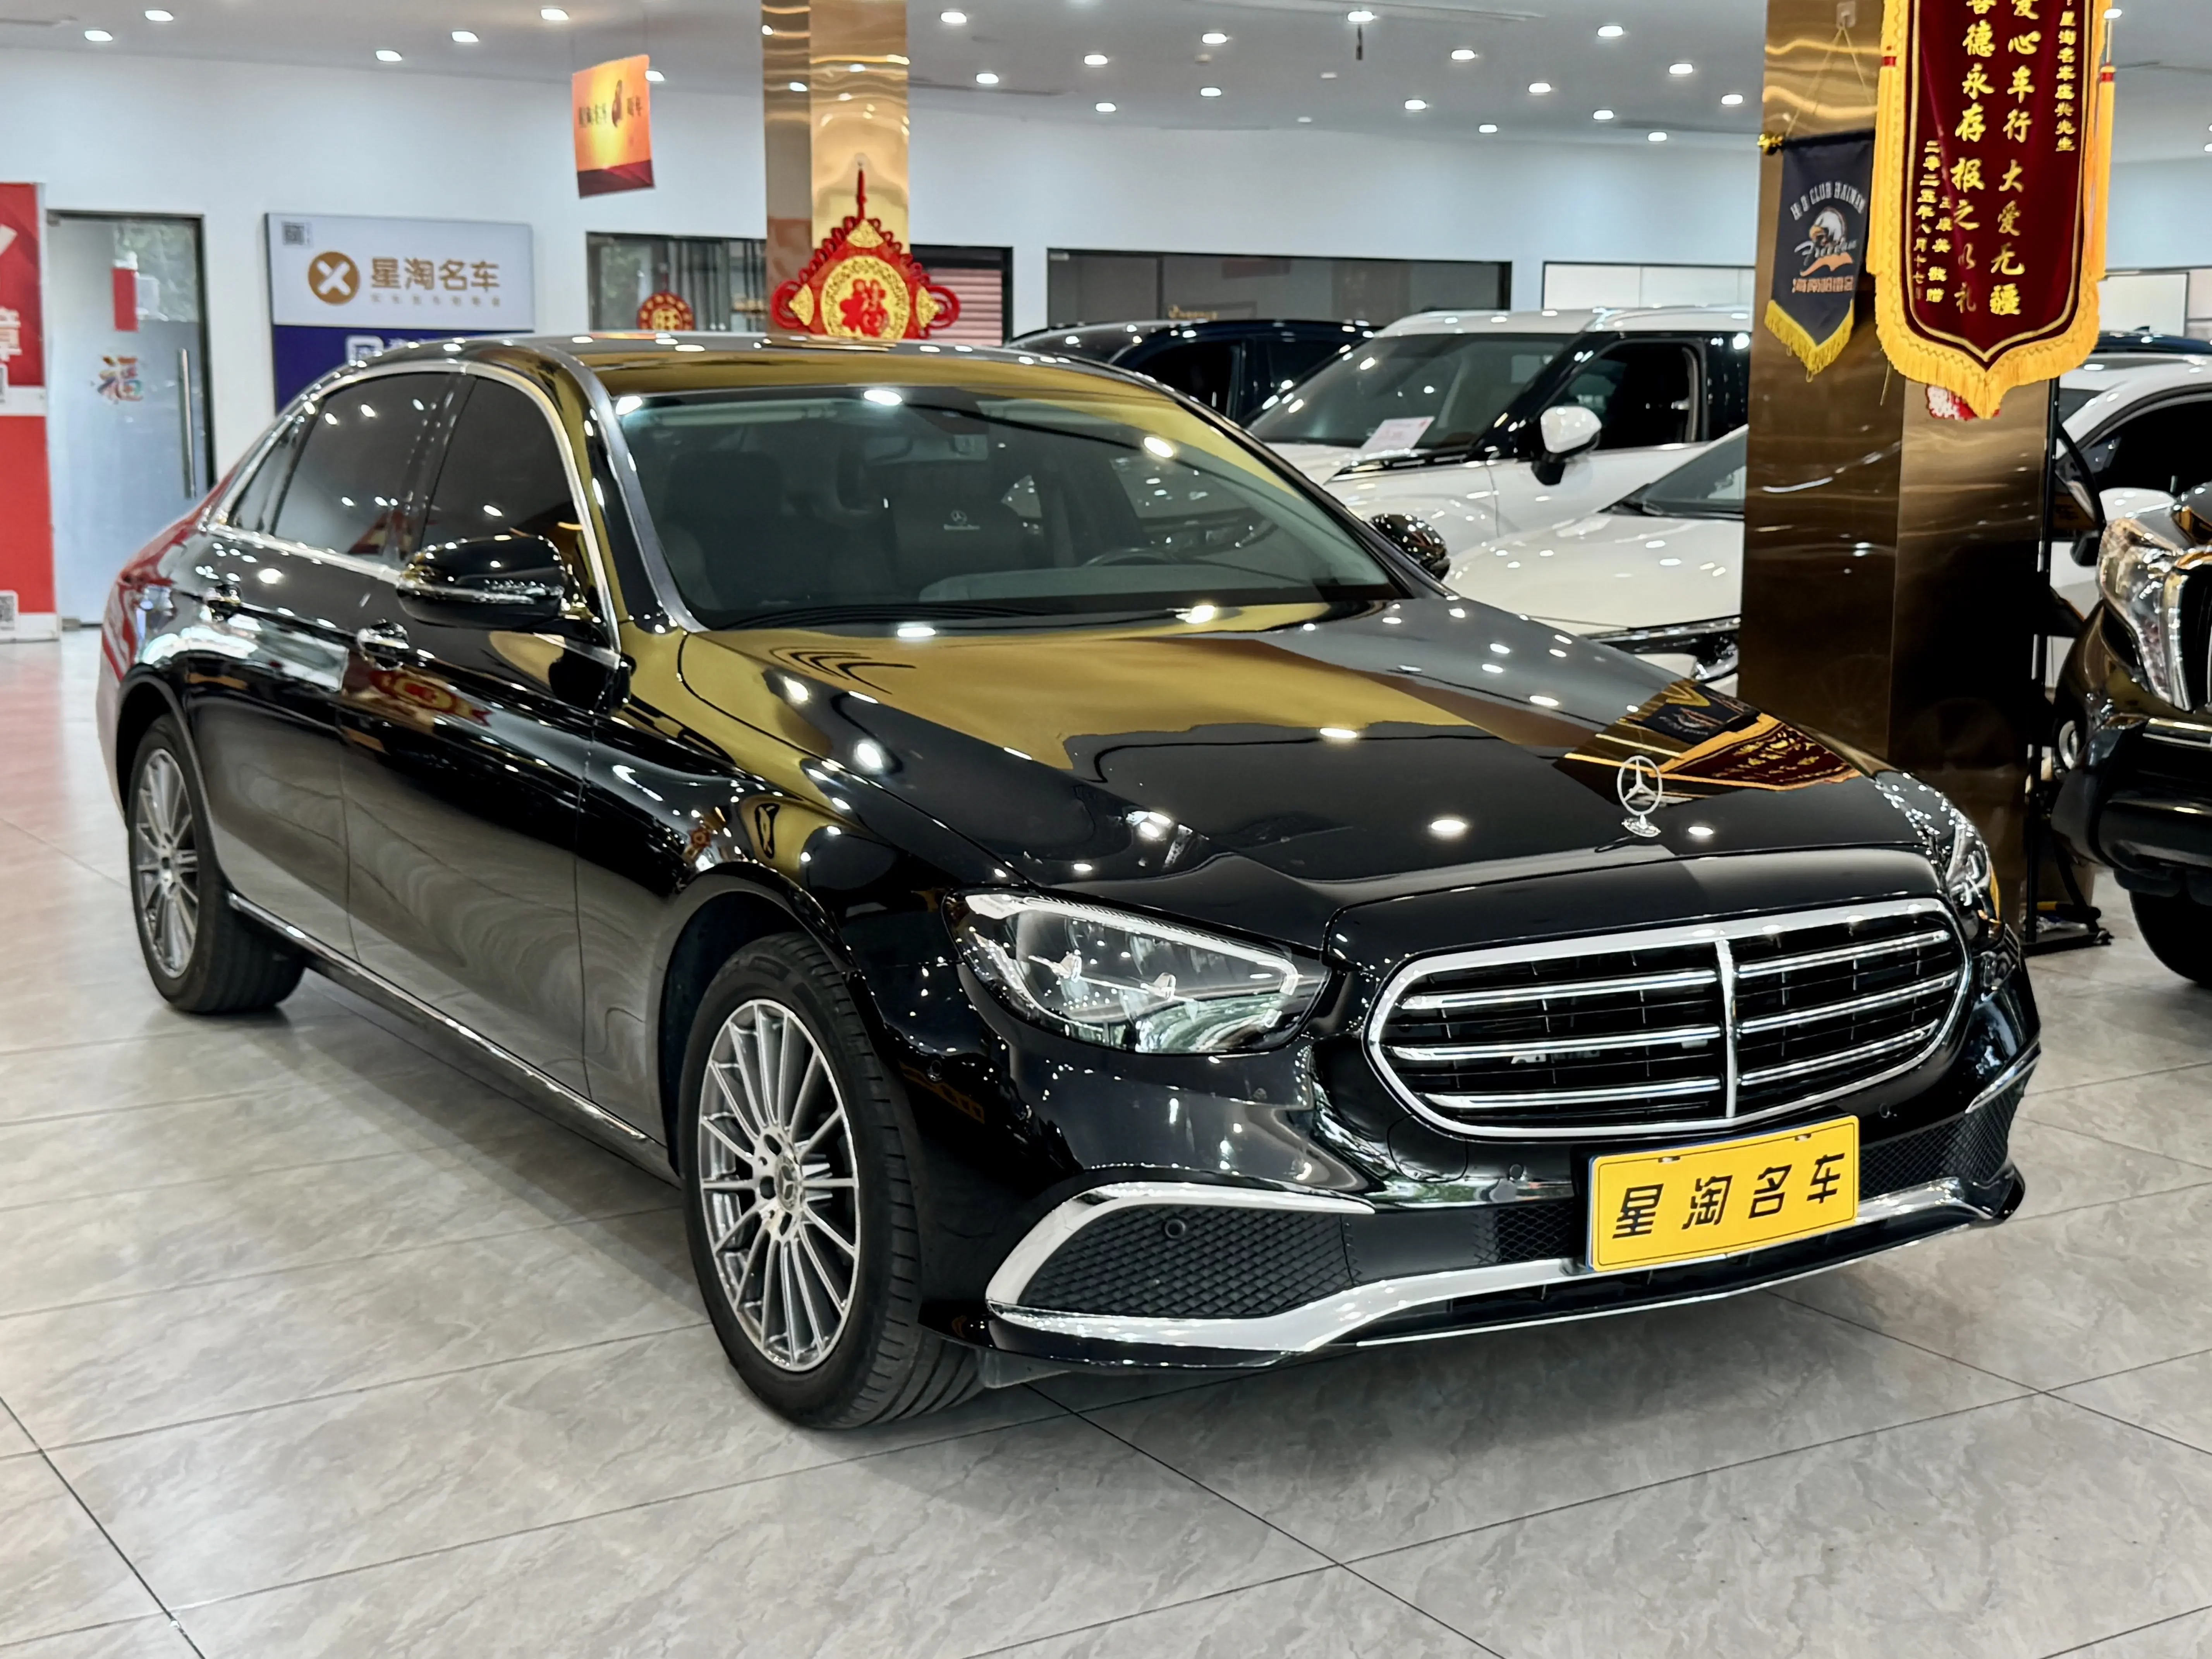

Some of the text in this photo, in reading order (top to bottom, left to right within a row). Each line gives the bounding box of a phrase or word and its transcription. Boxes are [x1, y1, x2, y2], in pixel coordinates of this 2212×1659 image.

[371, 257, 500, 292] 星淘名车
[1612, 1153, 1845, 1239] 星淘名车
